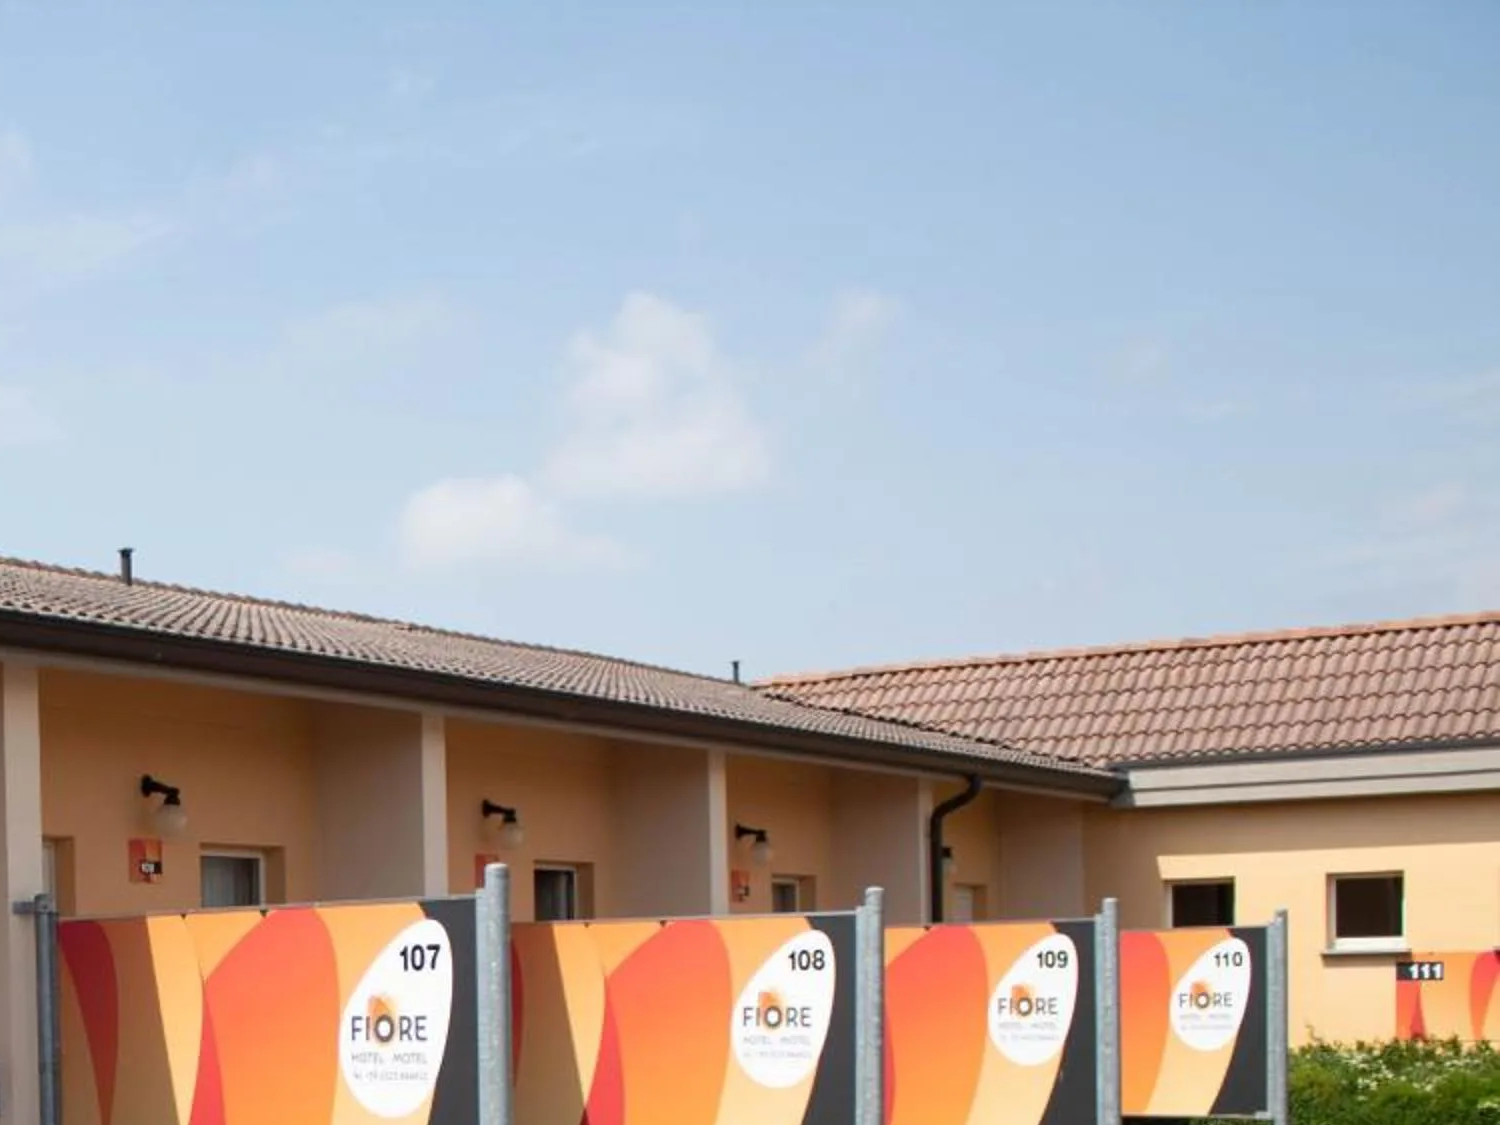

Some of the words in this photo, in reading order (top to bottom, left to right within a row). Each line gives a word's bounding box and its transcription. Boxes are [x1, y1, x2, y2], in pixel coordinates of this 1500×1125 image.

[399, 944, 441, 972] 107
[787, 949, 826, 971] 108
[1036, 951, 1069, 969] 109
[1213, 951, 1243, 968] 110
[1408, 963, 1442, 979] 111
[997, 996, 1059, 1017] FIORE
[1178, 991, 1233, 1009] FIORE
[743, 1005, 812, 1029] FIORE
[351, 1014, 428, 1043] FIORE
